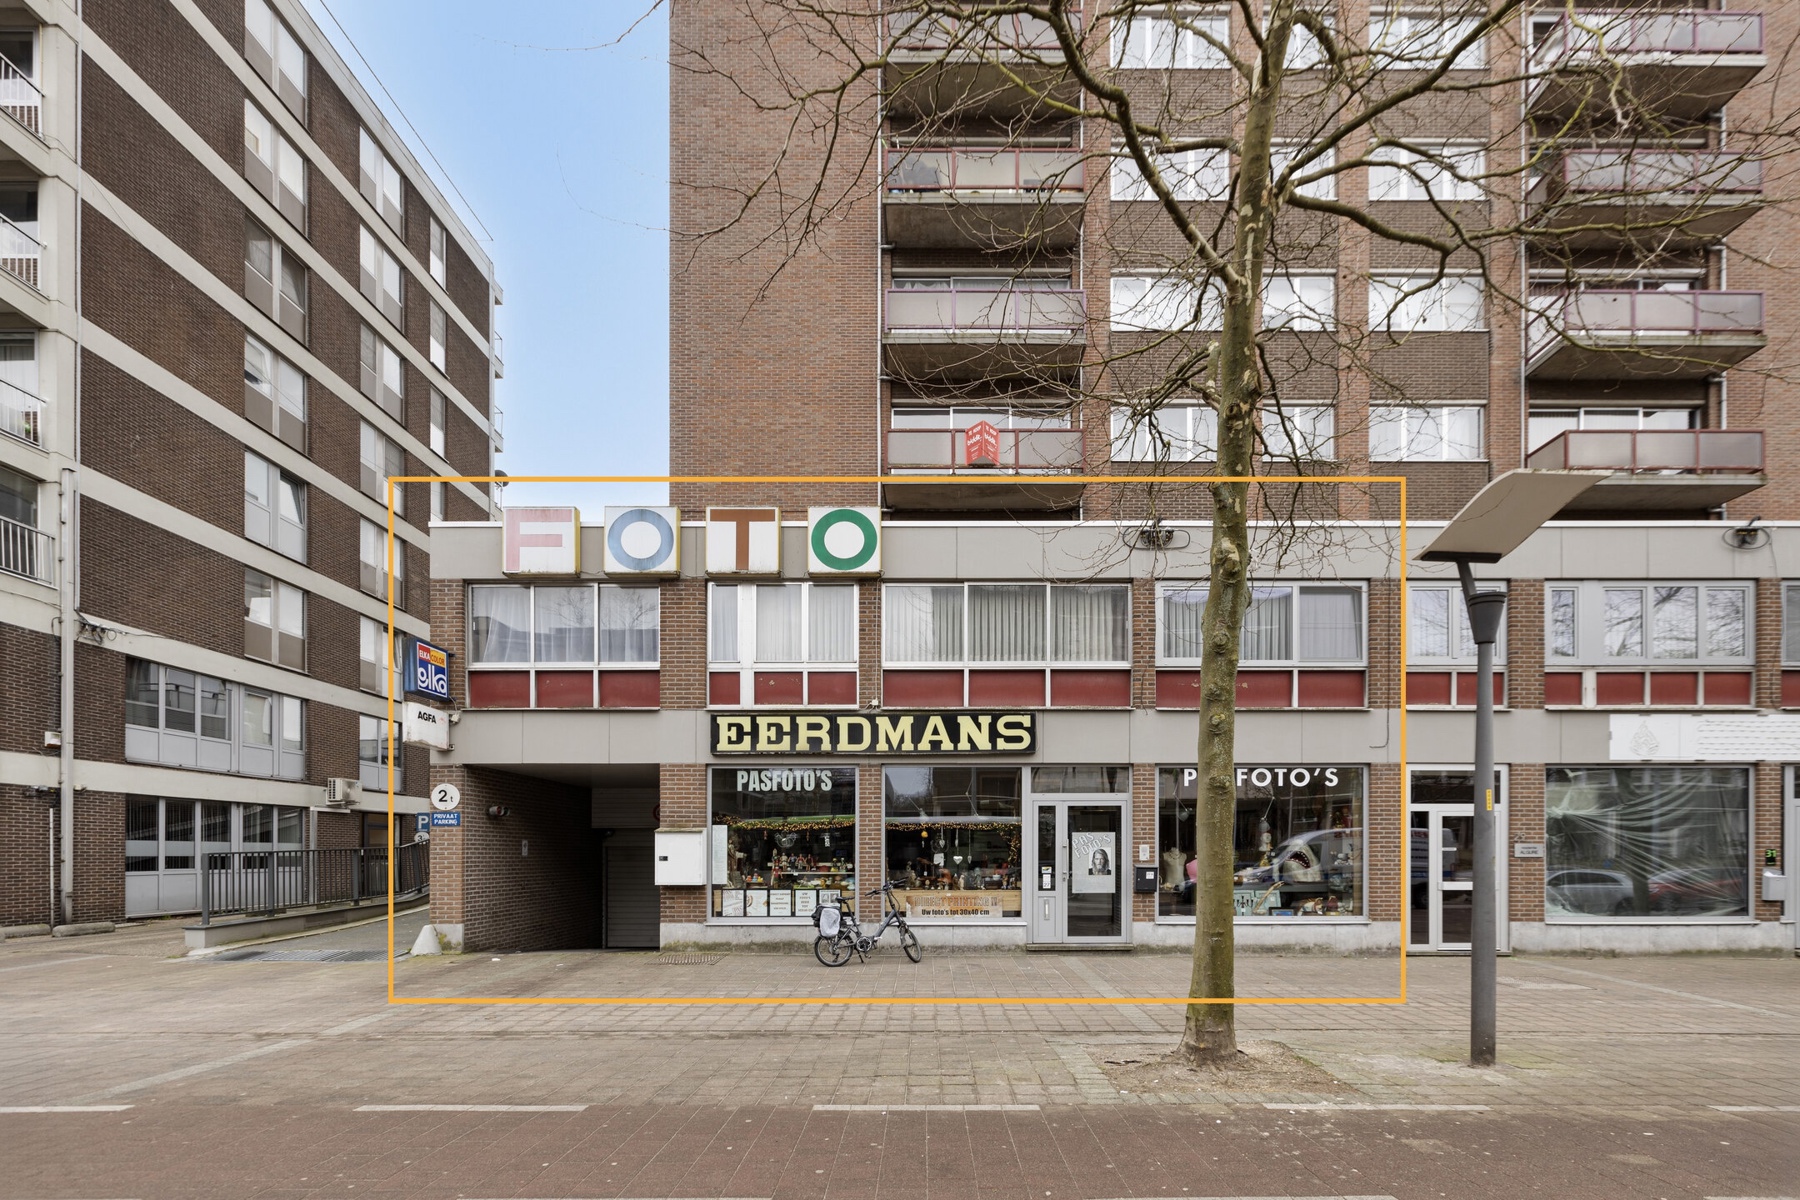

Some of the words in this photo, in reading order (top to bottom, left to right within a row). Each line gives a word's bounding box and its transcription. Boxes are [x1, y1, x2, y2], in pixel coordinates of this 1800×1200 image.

[505, 508, 878, 571] FOTO
[431, 654, 445, 666] COLOR
[418, 664, 446, 693] elka
[418, 711, 437, 724] AGFA
[716, 714, 1032, 752] EERDMANS
[736, 770, 833, 792] PASFOTO'S
[1183, 767, 1339, 787] PFOTO'S
[438, 790, 448, 802] 2
[418, 816, 429, 829] P
[1072, 832, 1094, 849] PAS
[1074, 834, 1111, 858] FOTO'S
[1765, 849, 1777, 857] 31
[915, 896, 945, 906] DIRECT
[947, 896, 989, 906] PRINTING
[932, 907, 949, 915] foto's
